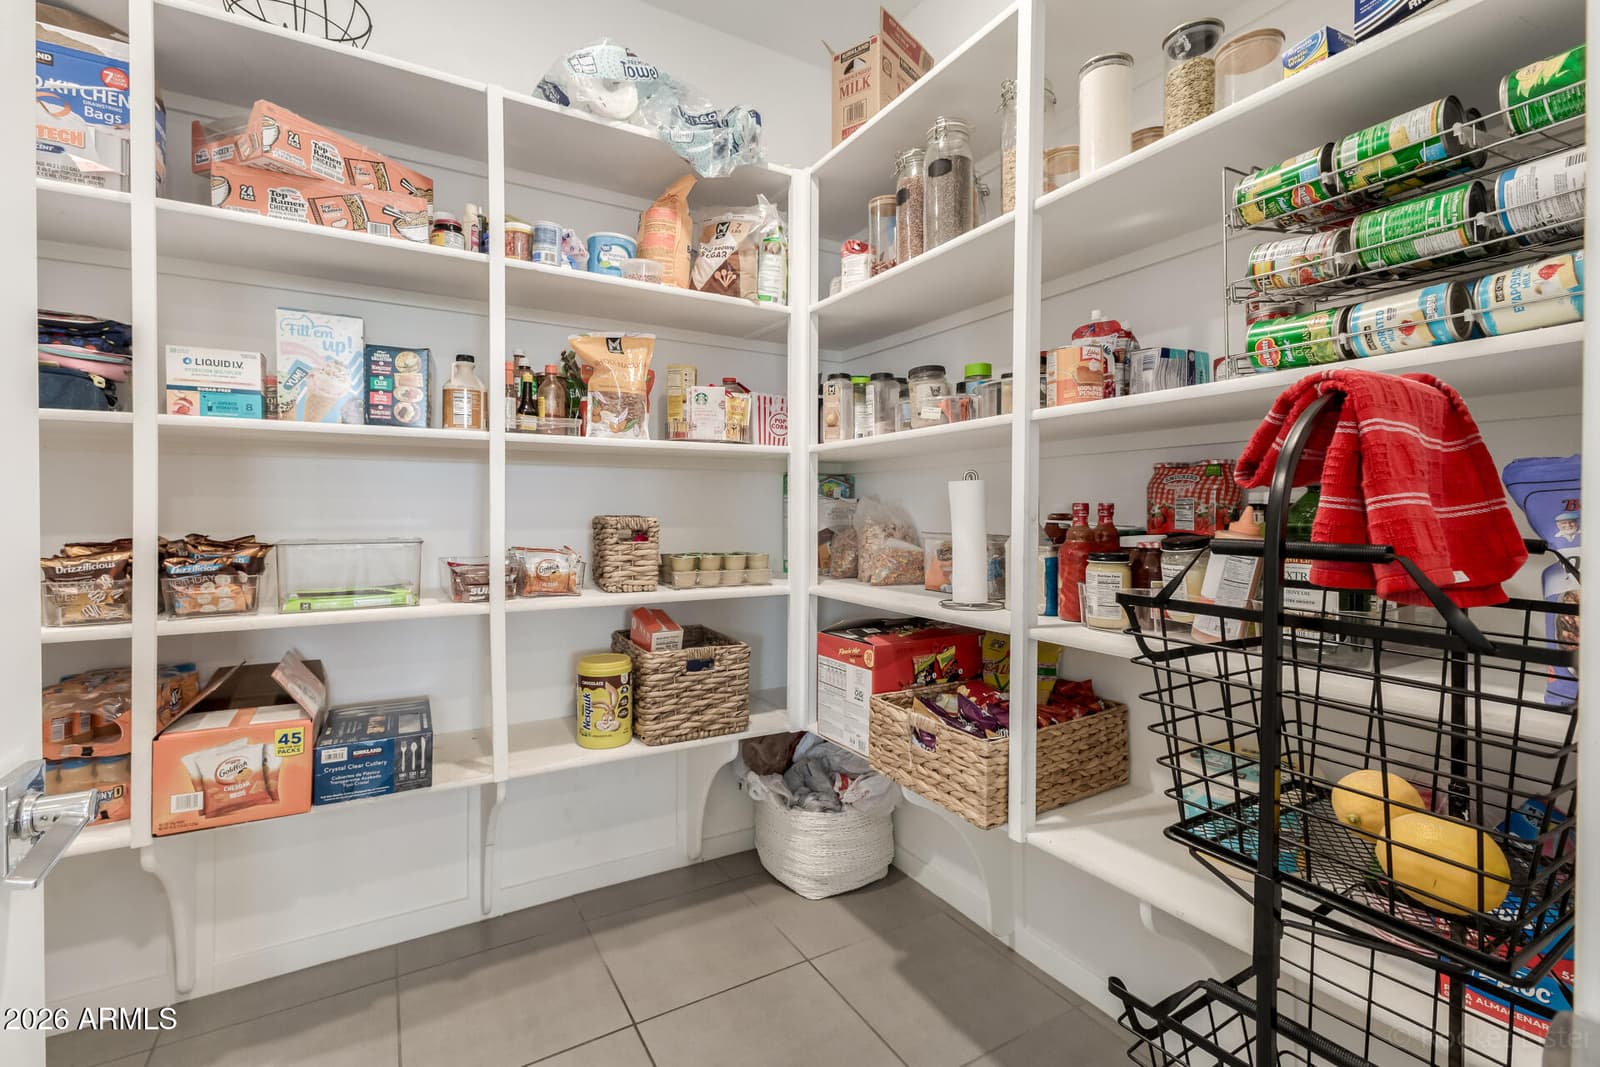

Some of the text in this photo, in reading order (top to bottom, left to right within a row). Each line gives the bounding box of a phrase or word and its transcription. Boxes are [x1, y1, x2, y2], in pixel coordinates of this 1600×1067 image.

[104, 70, 114, 83] 7
[620, 60, 659, 80] Towel
[49, 78, 130, 108] KITCHEN
[839, 73, 870, 99] MILK
[84, 106, 122, 124] Bags
[36, 125, 84, 148] TECH
[312, 141, 328, 154] Top
[313, 149, 342, 166] Ramen
[269, 189, 288, 200] Top
[270, 196, 305, 208] Ramen
[270, 203, 299, 213] CHICKEN
[284, 323, 310, 337] Fill
[322, 335, 353, 357] up!
[195, 358, 231, 368] LIQUID
[286, 367, 307, 387] YUM!
[55, 562, 116, 575] Drizzilicious
[1286, 571, 1308, 581] XTR
[582, 692, 594, 730] Nesquik
[278, 731, 302, 745] 45
[218, 760, 248, 777] Goldfish
[323, 760, 387, 775] Crystal Clear Cutlery
[223, 780, 251, 792] CHEDDAR
[1475, 995, 1550, 1032] ALMAENAR
